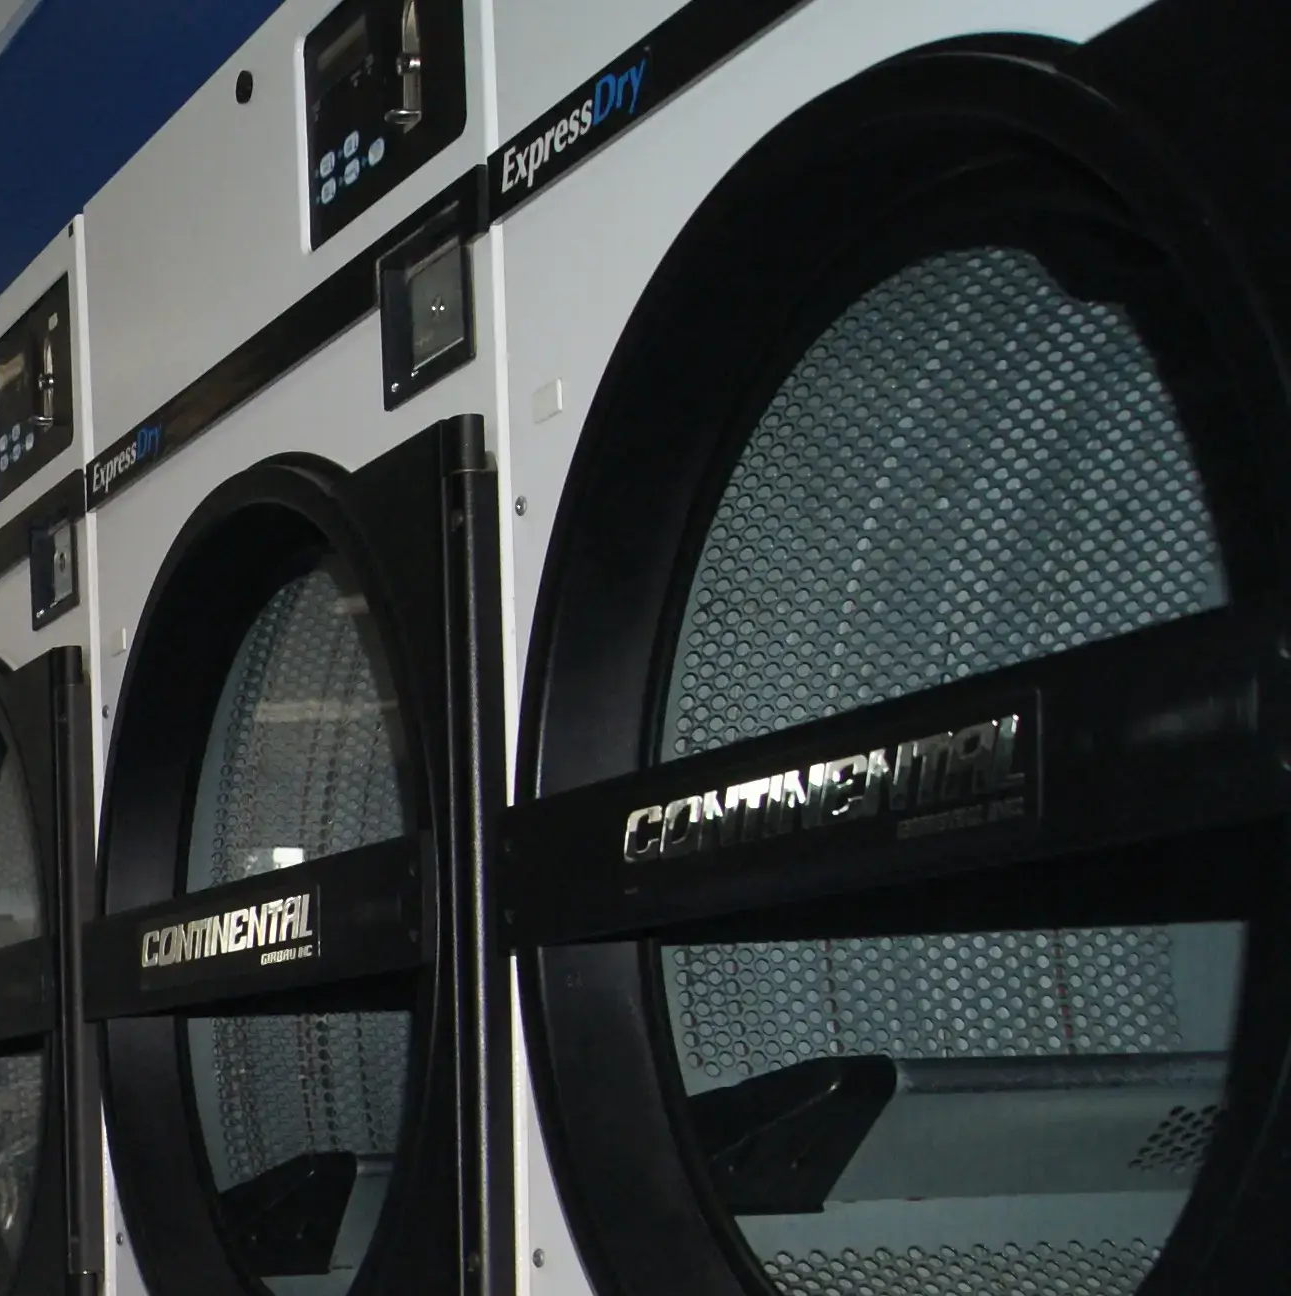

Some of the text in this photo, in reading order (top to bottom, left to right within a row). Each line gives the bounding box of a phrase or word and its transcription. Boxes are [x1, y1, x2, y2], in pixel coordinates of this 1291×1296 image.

[500, 57, 647, 193] ExpressDry
[623, 713, 1026, 864] CONTINENTAL
[141, 893, 313, 968] CONTINENTAL
